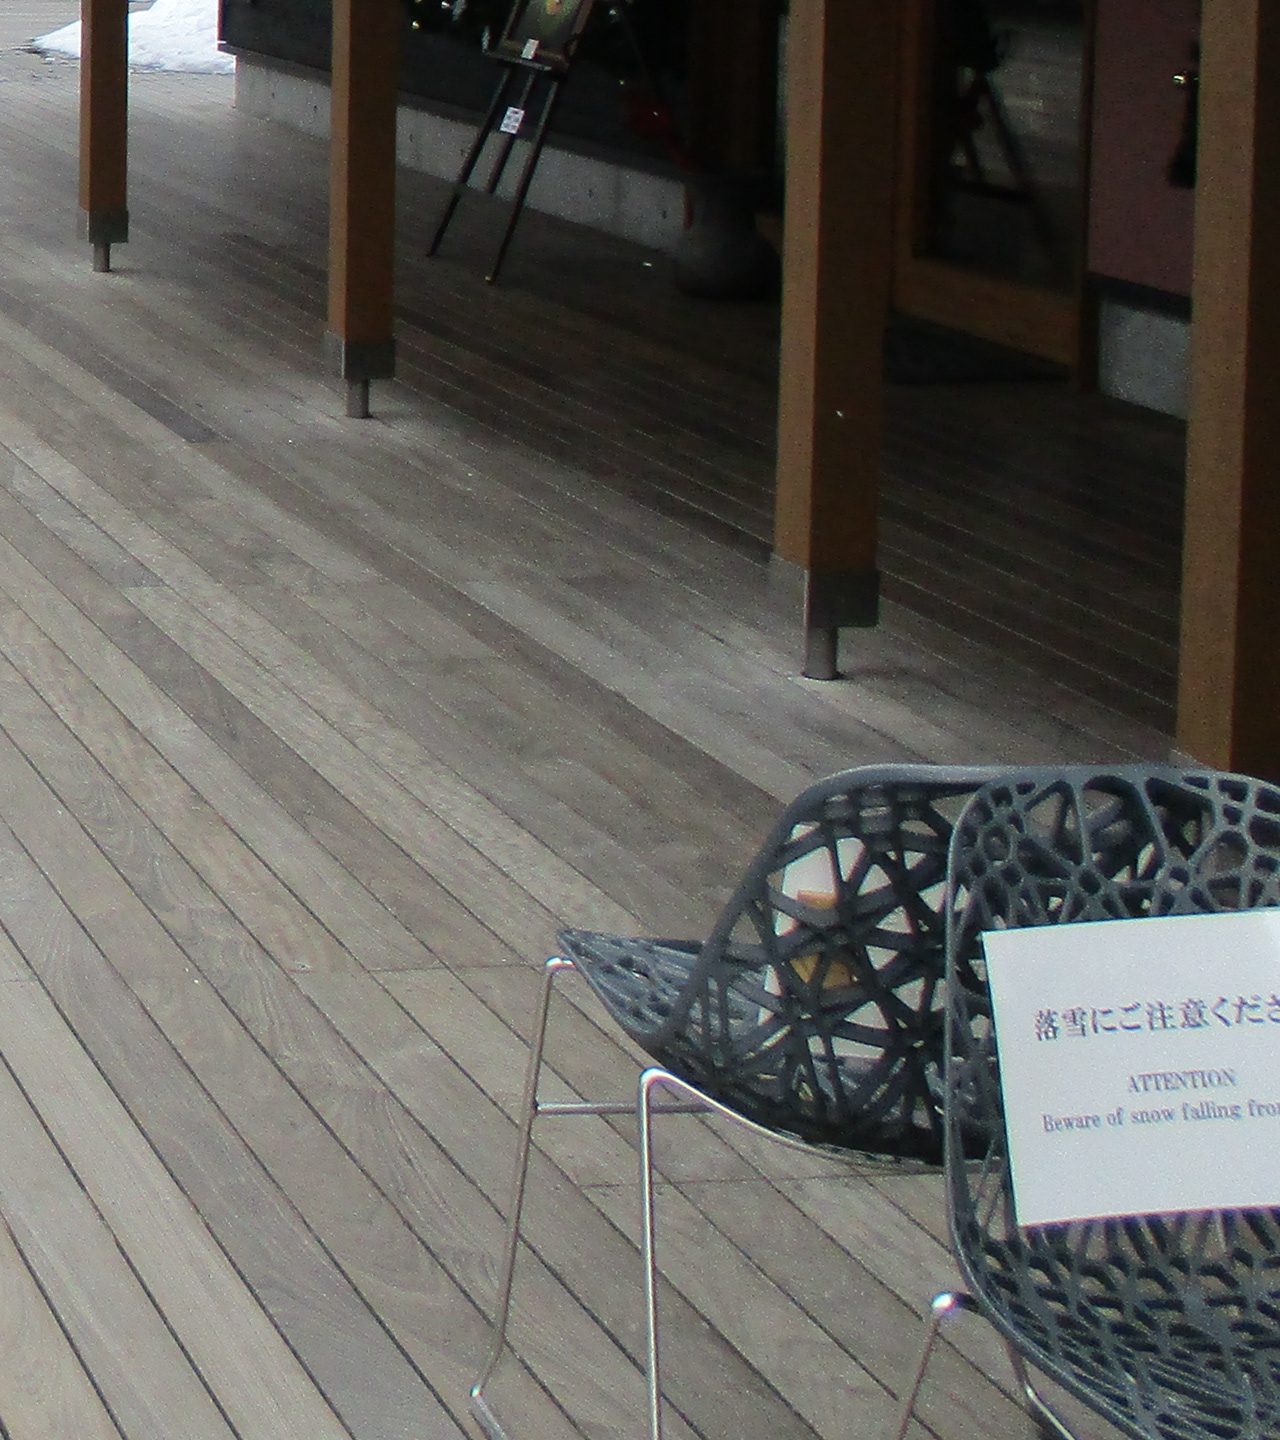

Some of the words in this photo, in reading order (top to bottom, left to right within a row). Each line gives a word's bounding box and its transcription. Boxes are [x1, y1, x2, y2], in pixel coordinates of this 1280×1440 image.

[1129, 1068, 1237, 1093] ATTENTION
[1043, 1113, 1100, 1132] Beware
[1106, 1107, 1123, 1126] of
[1130, 1109, 1174, 1124] snow
[1183, 1101, 1240, 1121] falling
[1249, 1099, 1280, 1118] fro
